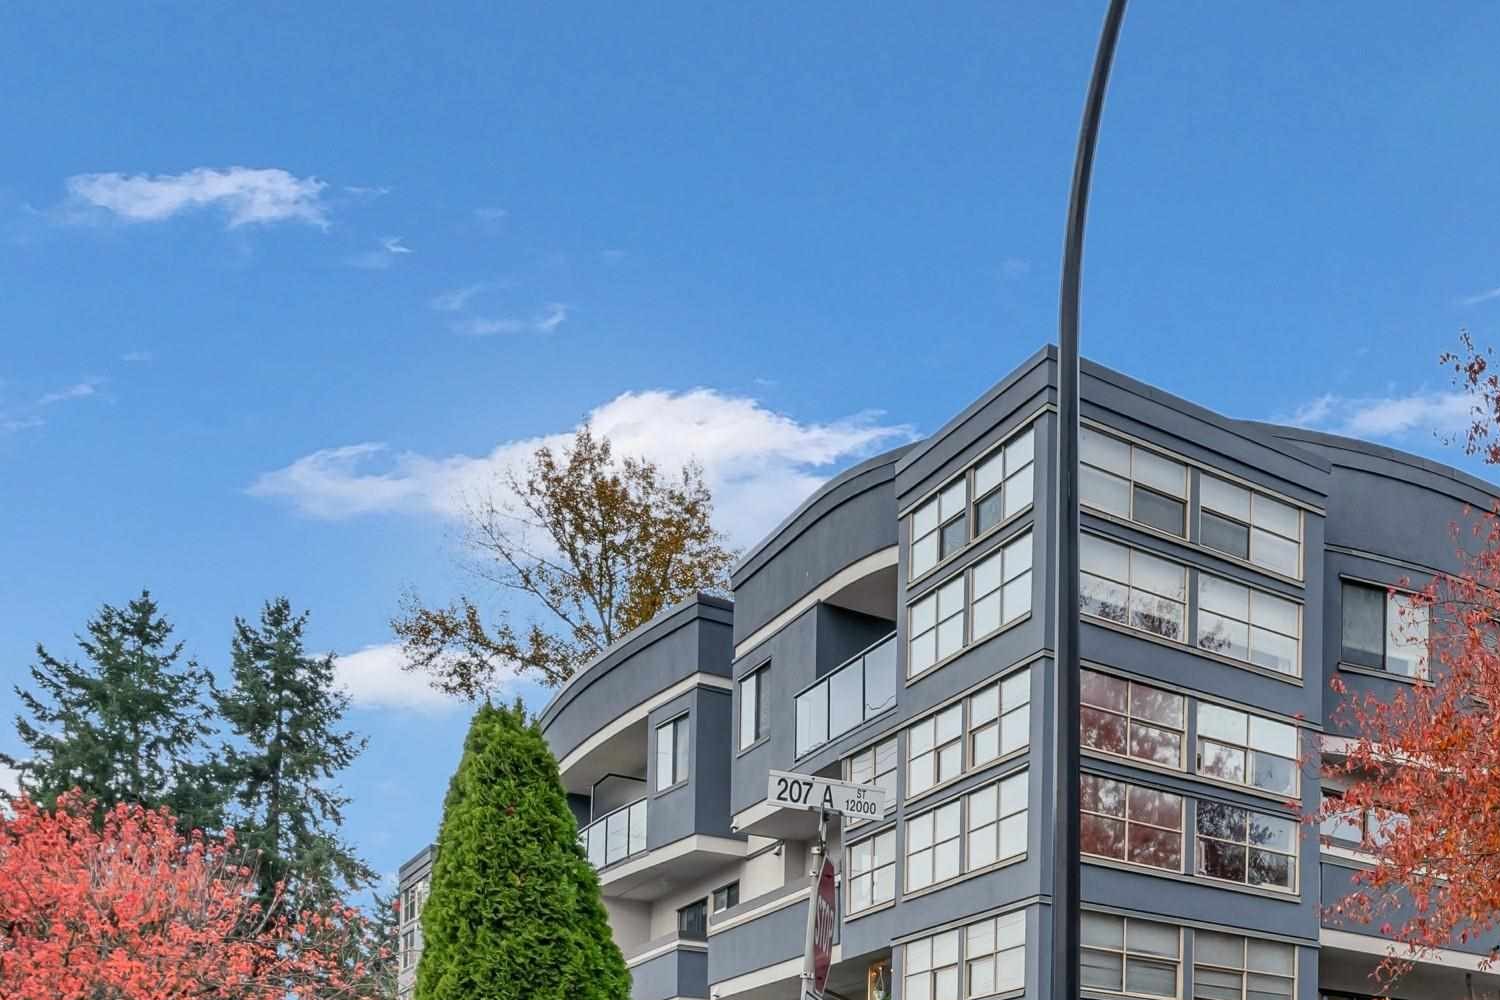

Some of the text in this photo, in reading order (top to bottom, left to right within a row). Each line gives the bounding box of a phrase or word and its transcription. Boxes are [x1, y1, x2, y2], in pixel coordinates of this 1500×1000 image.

[776, 777, 834, 808] 207 A
[856, 788, 867, 800] ST
[845, 799, 877, 815] 12000
[816, 896, 834, 957] STOP
